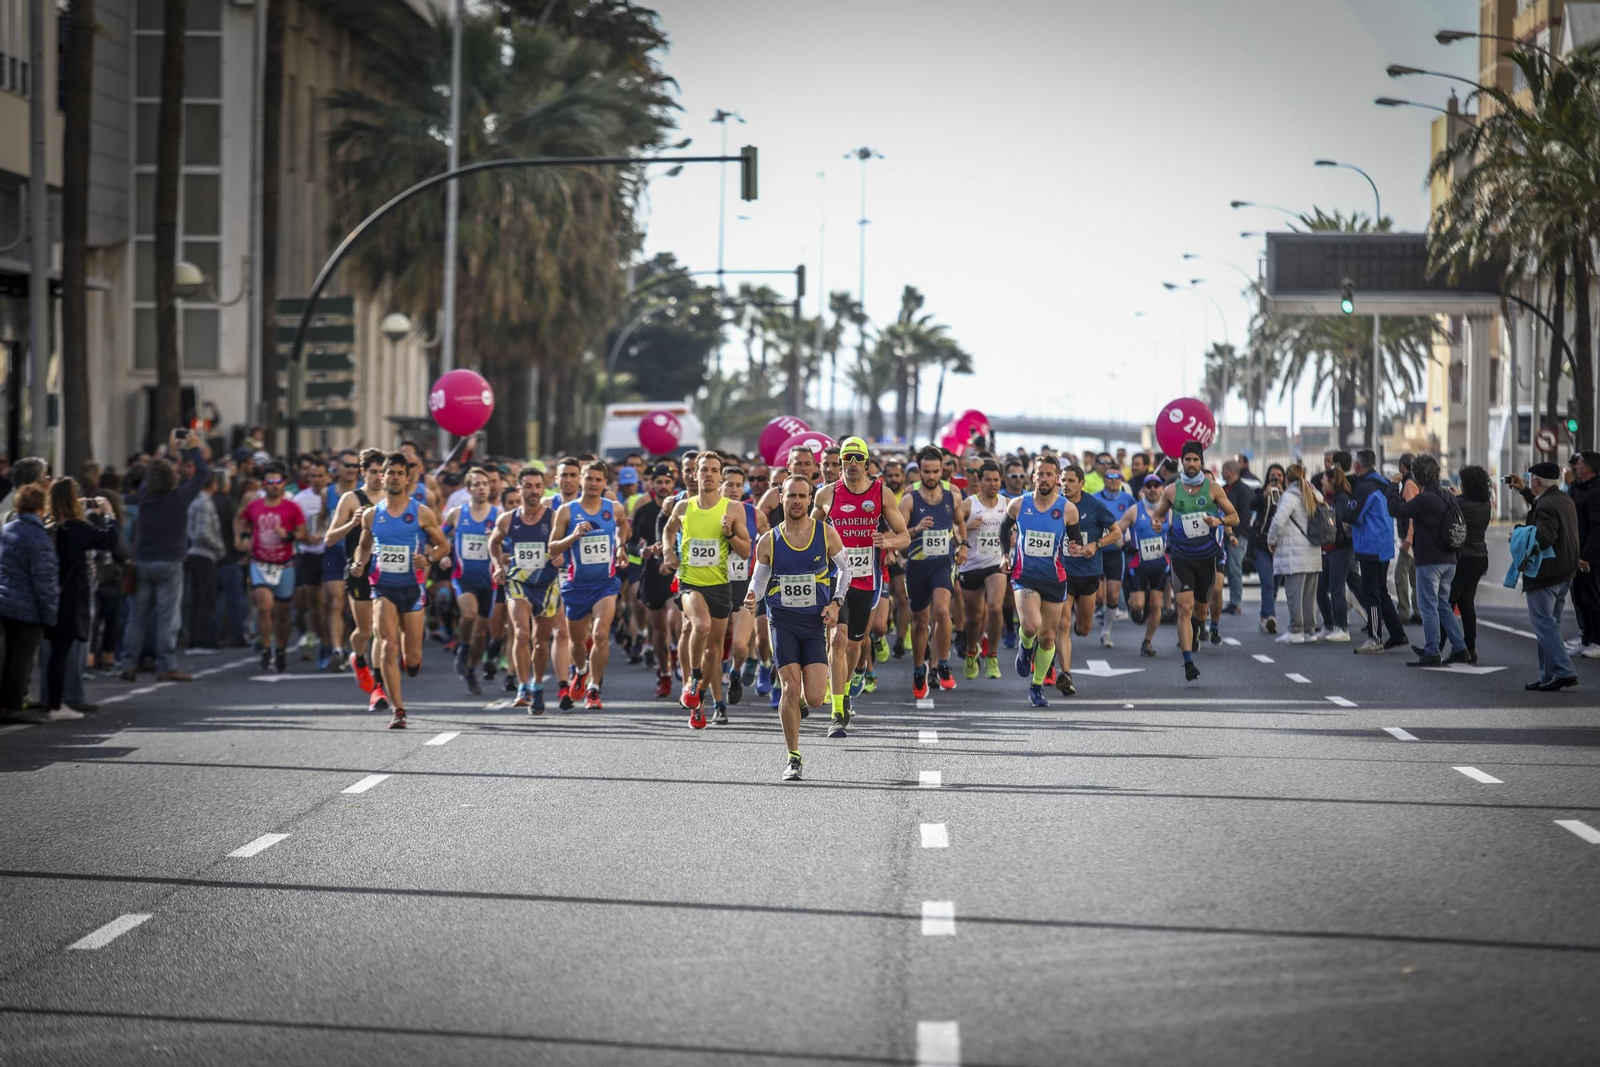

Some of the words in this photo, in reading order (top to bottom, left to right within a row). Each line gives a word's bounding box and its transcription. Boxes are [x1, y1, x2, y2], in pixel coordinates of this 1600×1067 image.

[834, 517, 878, 526] GADEIRAS
[1192, 520, 1199, 529] 5
[468, 542, 483, 551] 27
[926, 538, 946, 547] 851
[980, 538, 1000, 547] 745
[1028, 538, 1051, 548] 294
[584, 544, 607, 555] 615
[692, 547, 715, 557] 920
[1144, 544, 1161, 553] 184
[382, 553, 405, 563] 229
[518, 550, 540, 560] 891
[784, 584, 811, 596] 886
